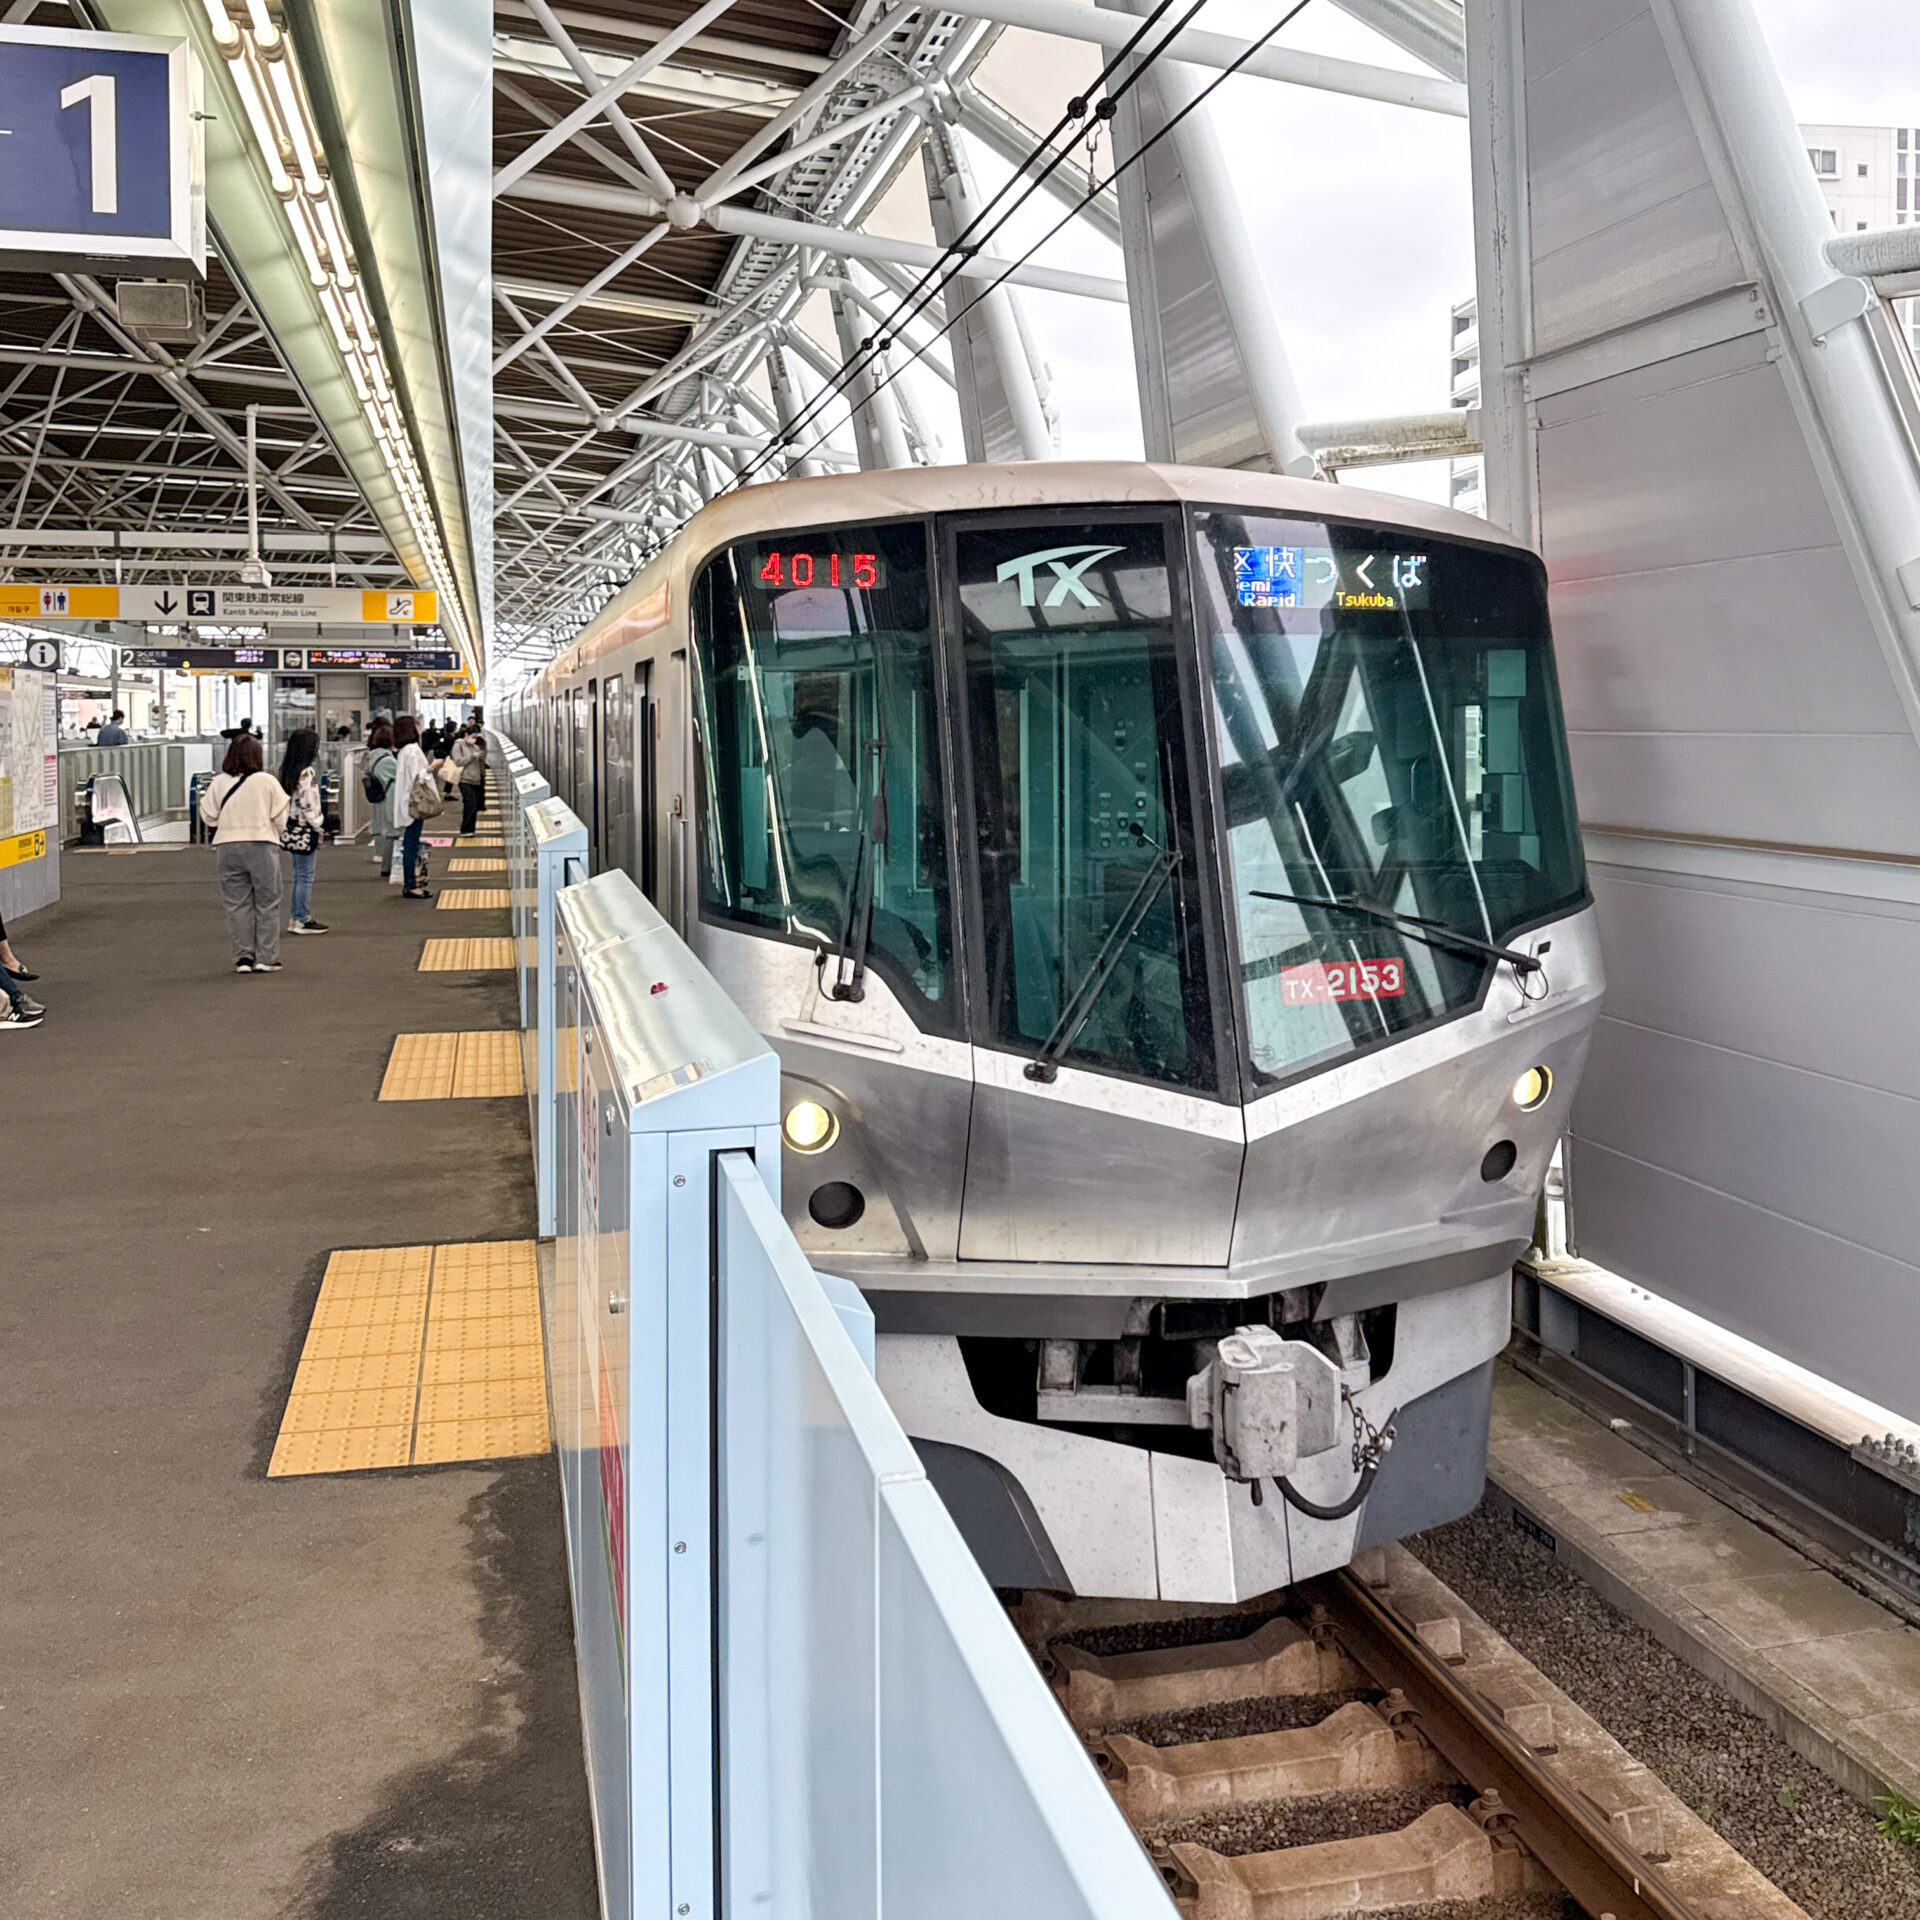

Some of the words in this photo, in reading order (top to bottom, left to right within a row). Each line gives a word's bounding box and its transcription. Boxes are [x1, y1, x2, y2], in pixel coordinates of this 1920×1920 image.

[61, 75, 117, 214] 1
[760, 553, 876, 587] 4015
[996, 545, 1127, 606] TX
[1305, 555, 1427, 588] つくば
[1236, 577, 1271, 592] emi
[1336, 592, 1394, 607] Tsukuba
[249, 608, 279, 618] Railway
[301, 609, 317, 617] Line
[122, 650, 134, 666] 2
[448, 653, 457, 669] 1
[1285, 964, 1400, 1000] TX-2153
